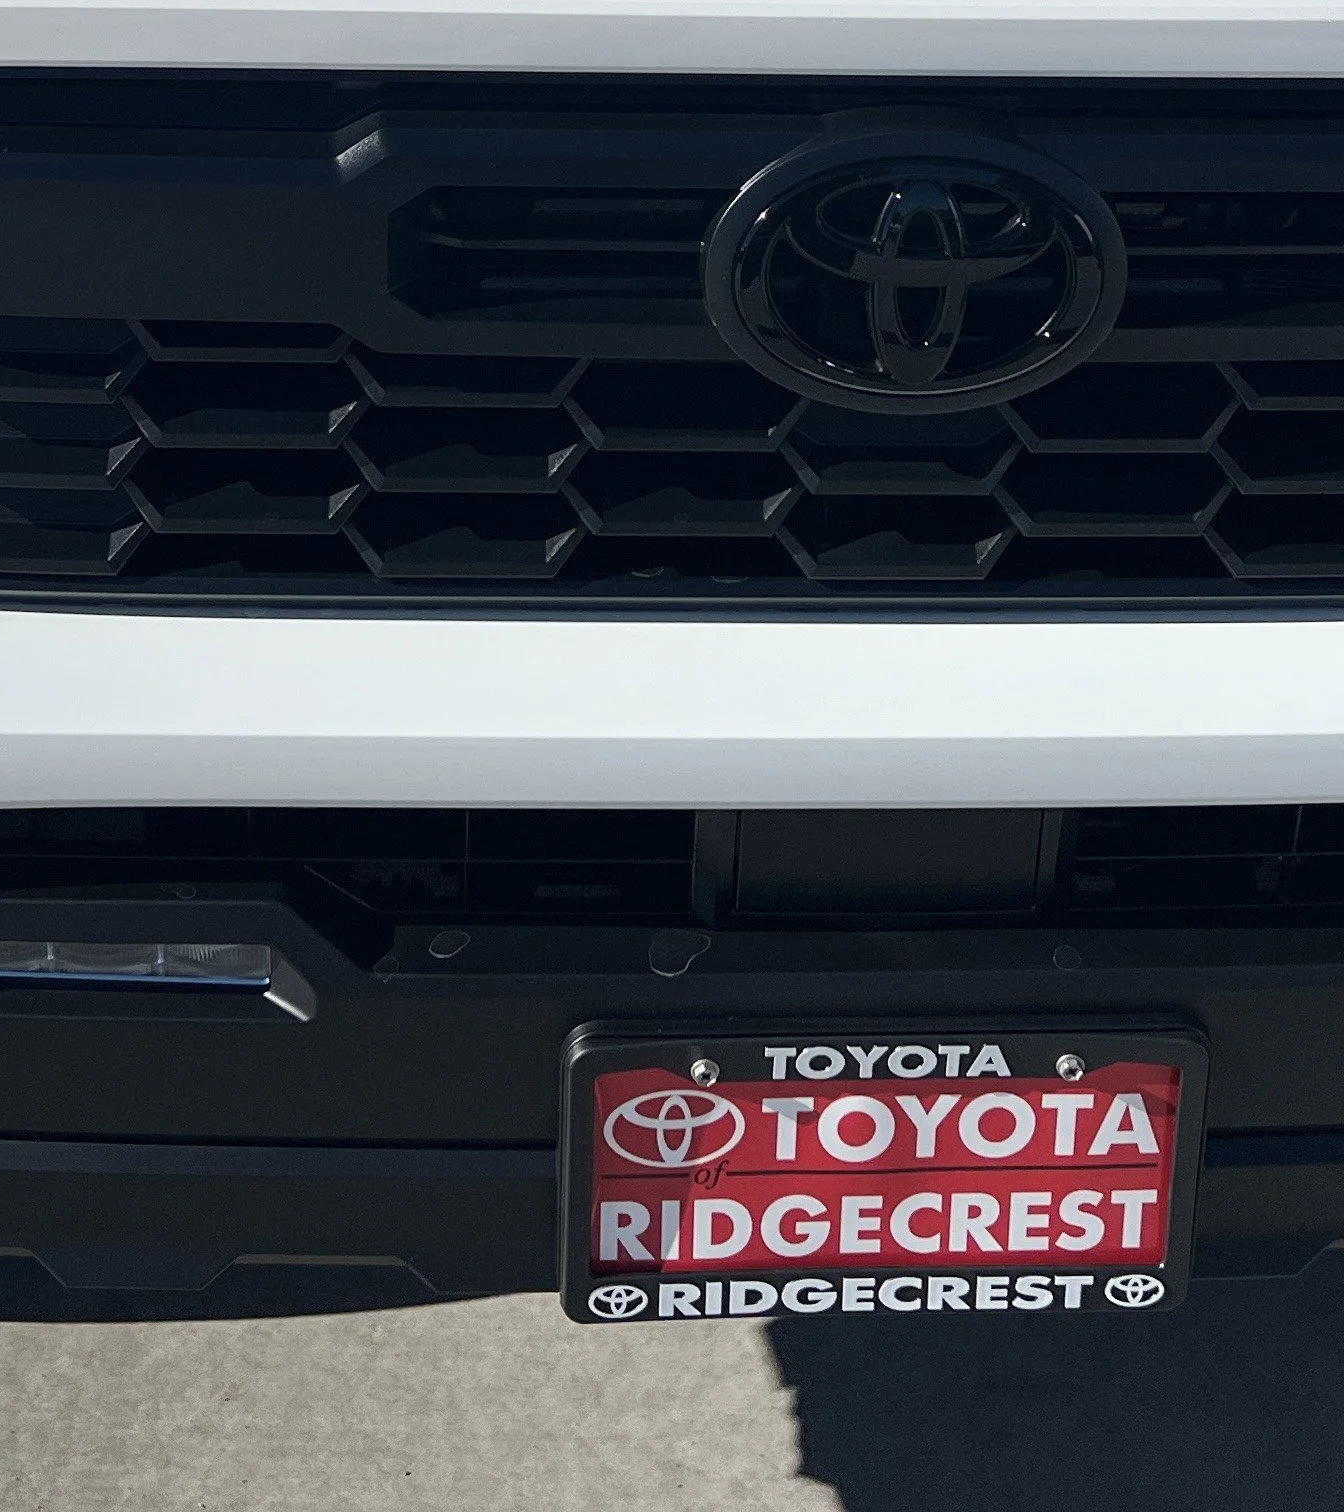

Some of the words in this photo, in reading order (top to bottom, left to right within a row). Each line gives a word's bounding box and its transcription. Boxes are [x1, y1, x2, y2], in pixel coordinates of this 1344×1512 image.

[764, 1043, 1012, 1080] TOYOTA
[761, 1091, 1160, 1163] TOYOTA
[694, 1159, 730, 1191] of
[599, 1189, 1158, 1261] RIDGECREST
[658, 1274, 1095, 1317] RIDGECREST
